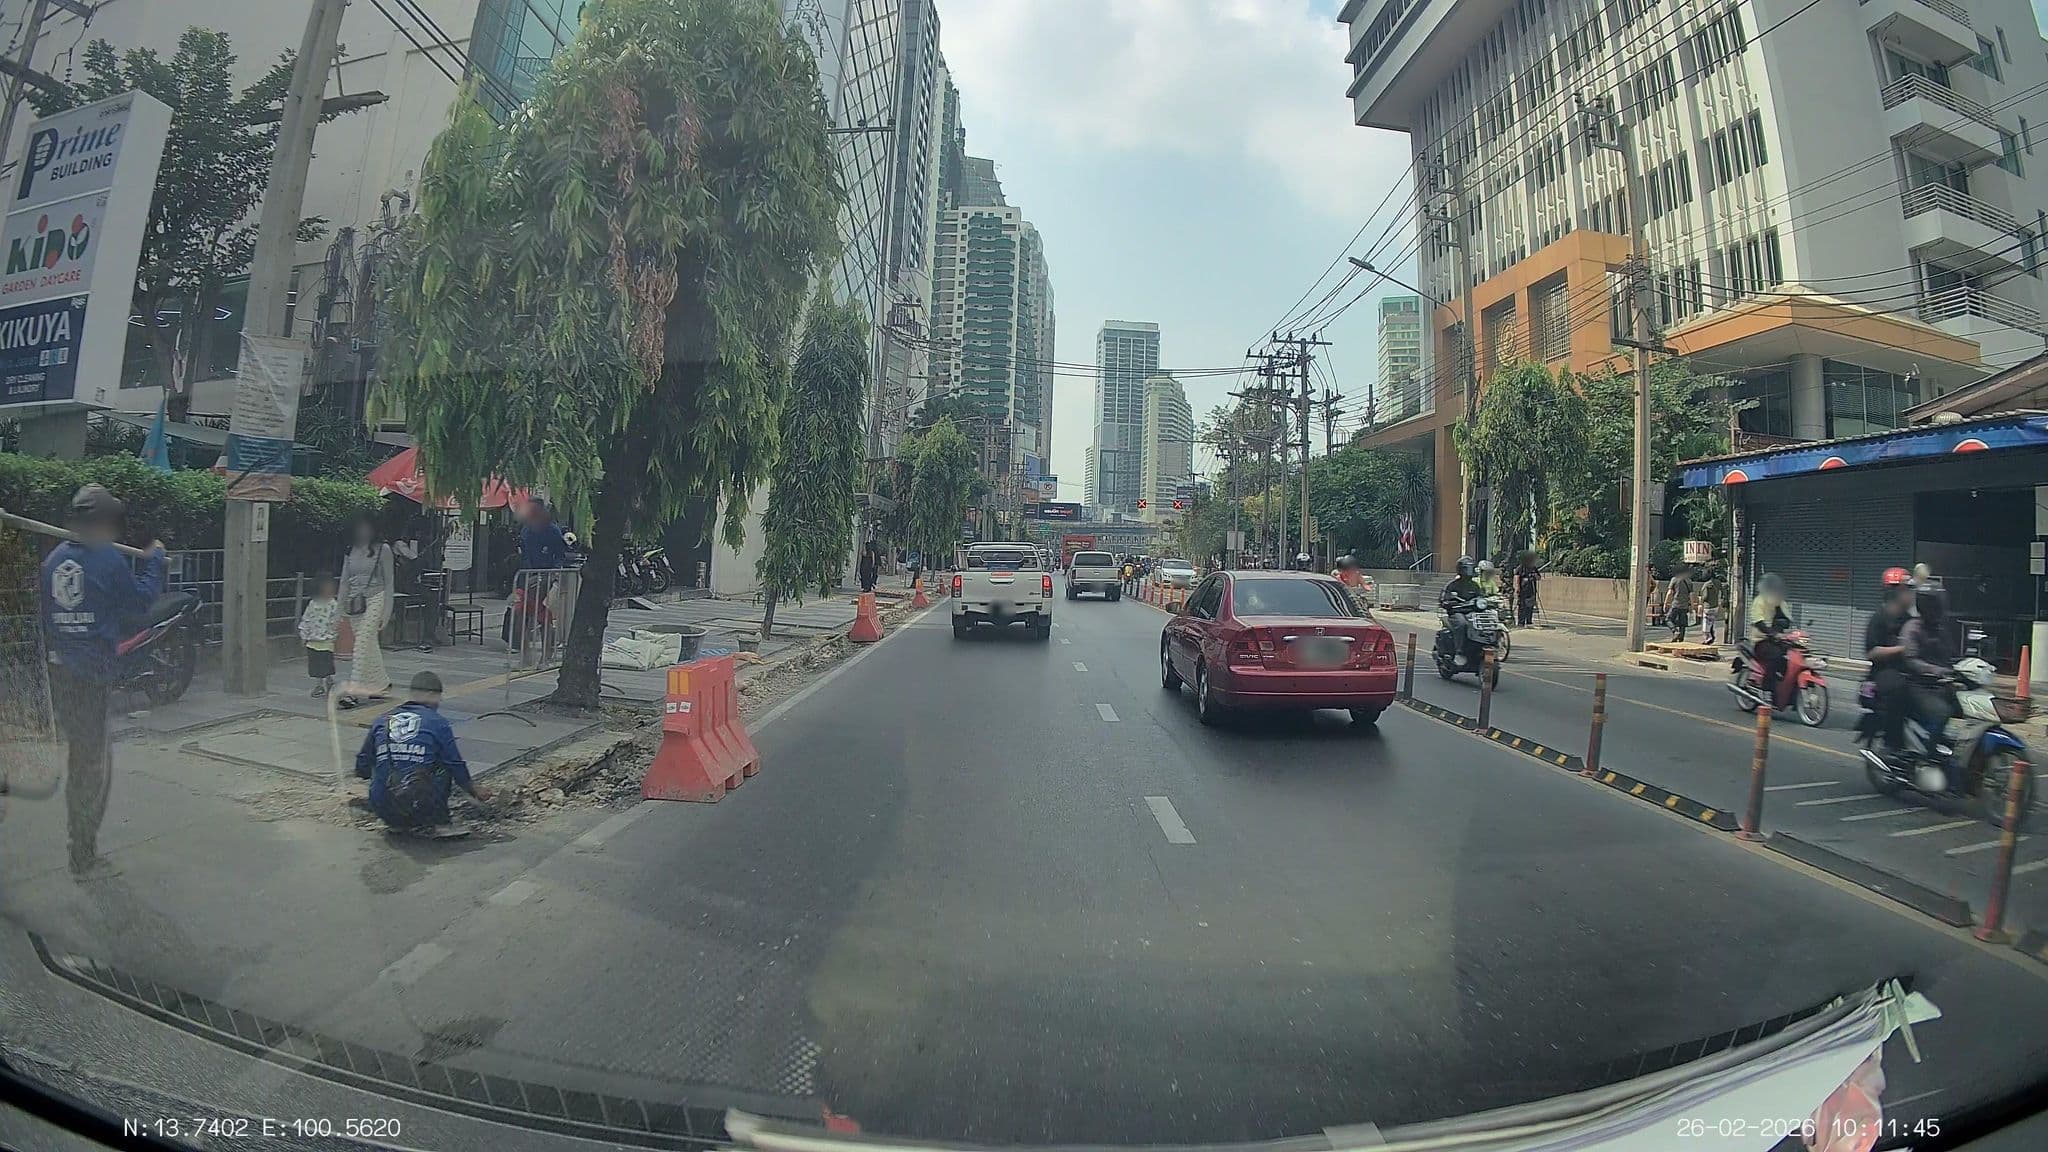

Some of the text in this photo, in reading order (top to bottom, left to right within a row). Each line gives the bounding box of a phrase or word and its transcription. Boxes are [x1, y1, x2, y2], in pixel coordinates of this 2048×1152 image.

[17, 122, 122, 200] Prime
[50, 152, 112, 181] BUILDING
[2, 269, 82, 295] GARDEN DAYCARE
